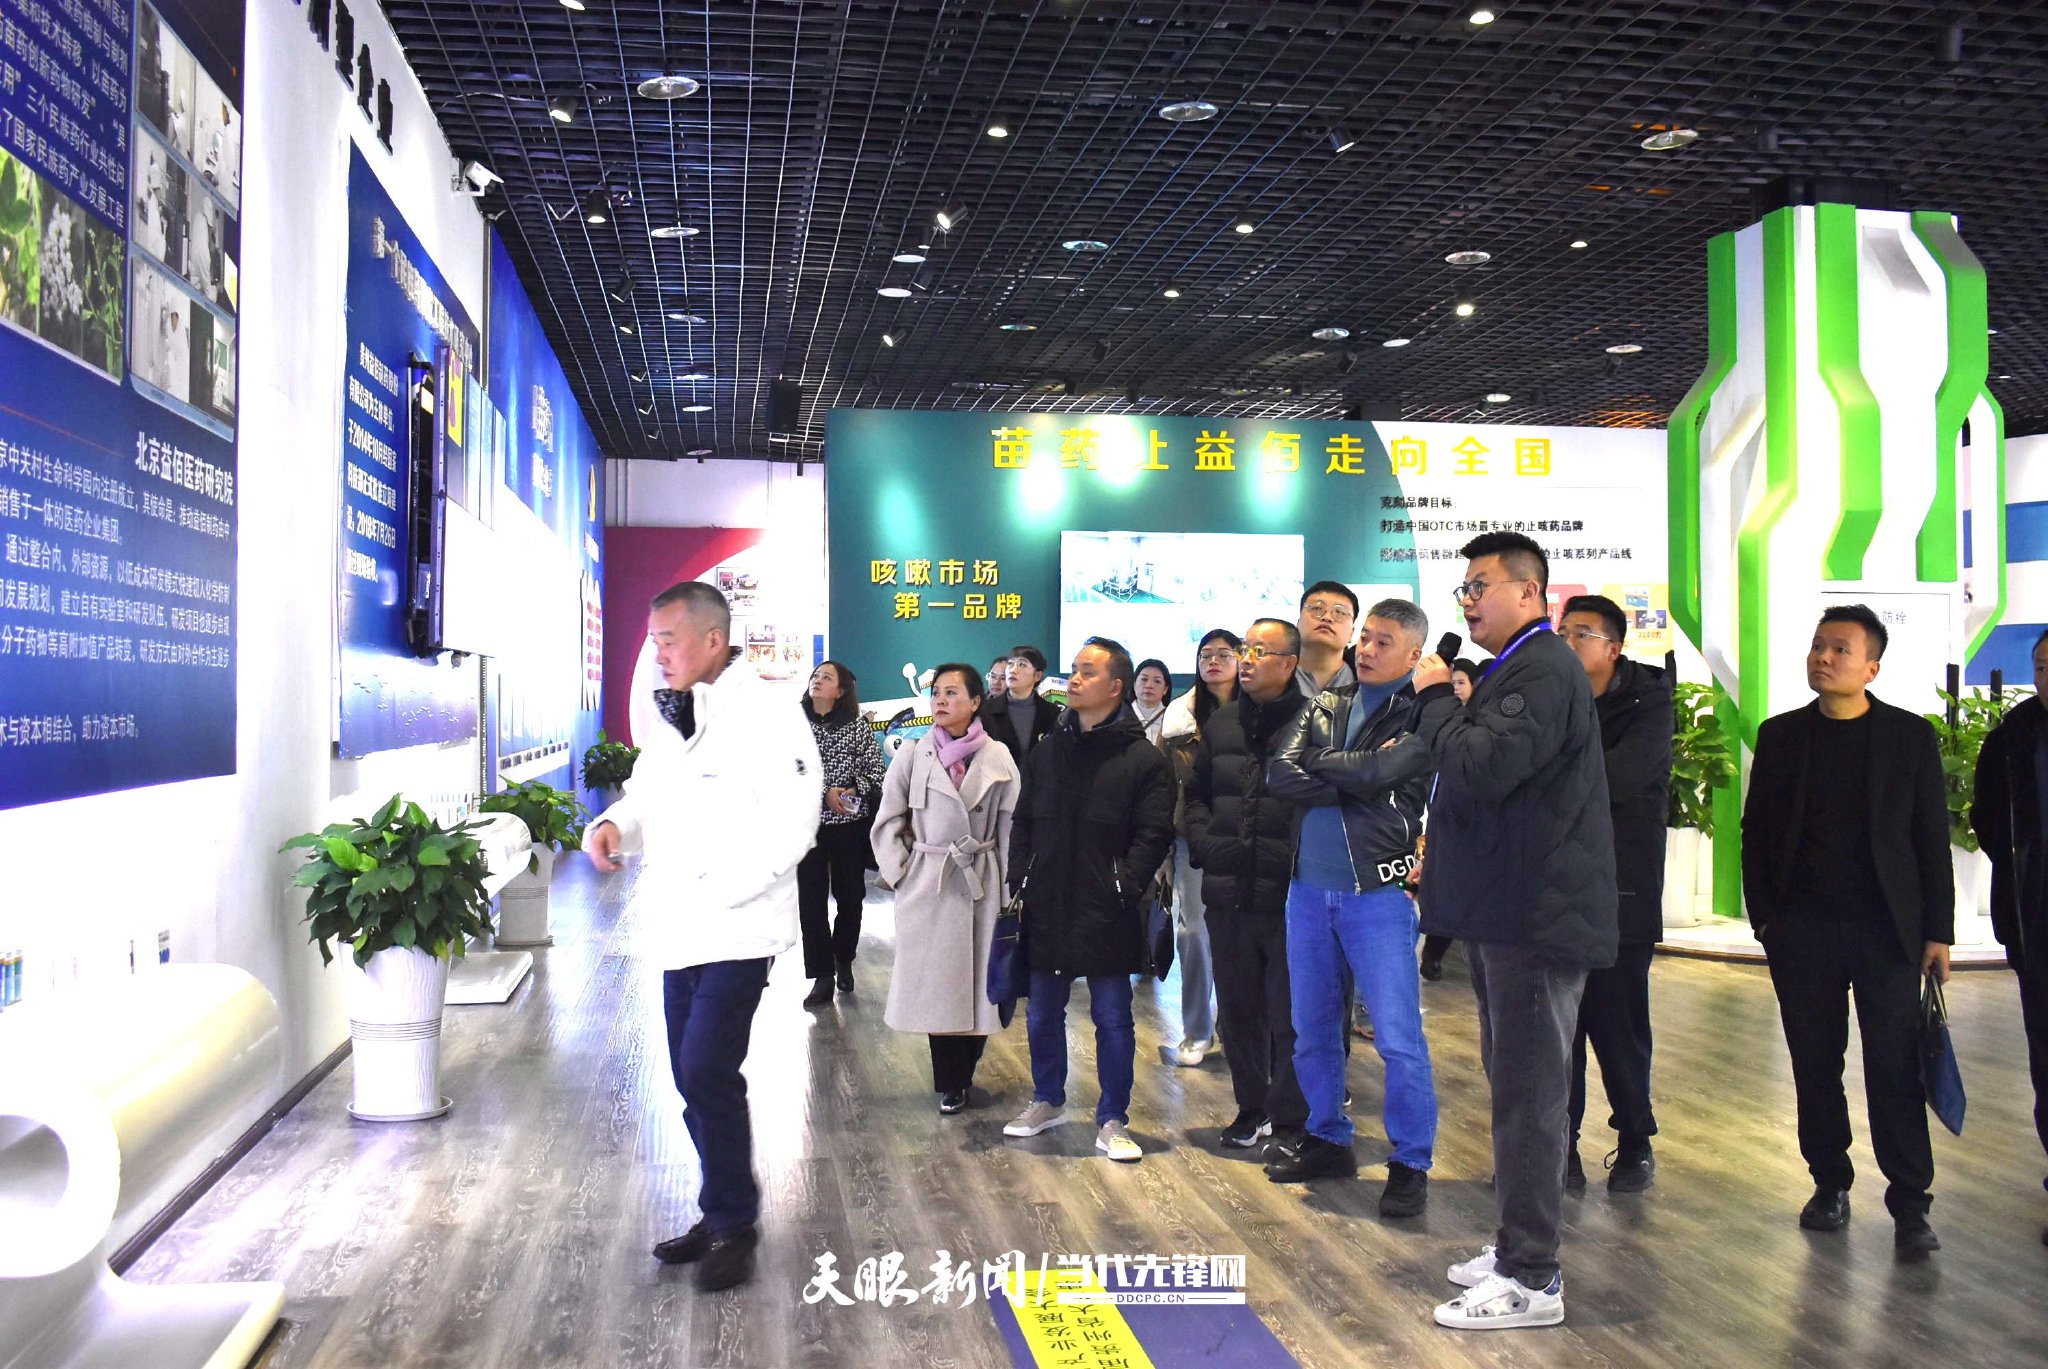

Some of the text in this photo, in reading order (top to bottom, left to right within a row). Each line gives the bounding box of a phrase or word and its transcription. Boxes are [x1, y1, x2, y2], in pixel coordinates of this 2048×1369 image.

[0, 107, 124, 229] 了国家民族药产业发展工程
[135, 431, 234, 506] 北京益佰医药研究院
[870, 558, 999, 586] 咳嗽市场
[893, 591, 1023, 620] 第一品牌
[1880, 610, 1907, 625] 防栓
[0, 623, 230, 669] 分子药物等高附加值产品转变，研发方式由对外合作为主逐步
